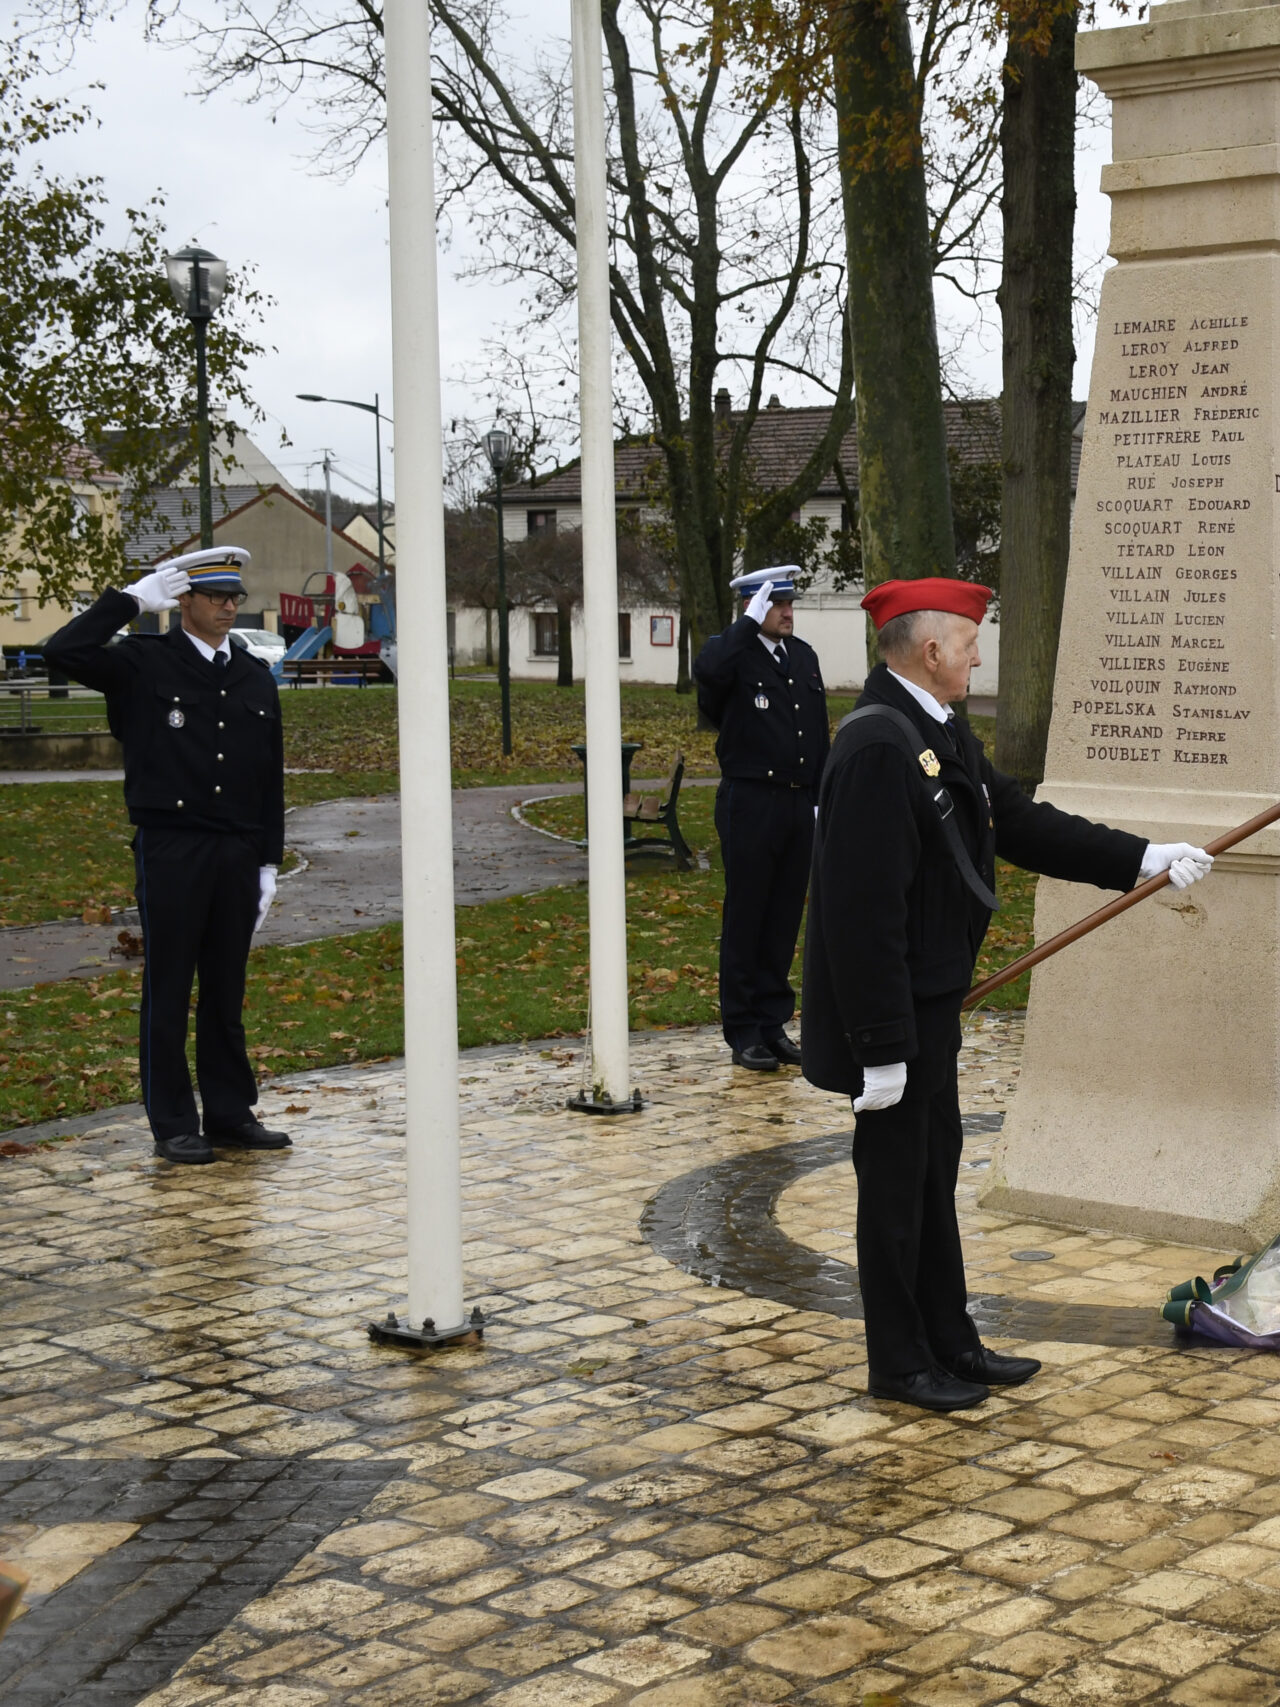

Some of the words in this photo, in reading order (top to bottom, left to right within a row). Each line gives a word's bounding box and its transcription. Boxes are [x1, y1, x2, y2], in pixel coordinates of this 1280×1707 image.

[1114, 319, 1175, 335] LEMAIRE
[1190, 317, 1248, 330] ACHILLE
[1122, 342, 1170, 357] LEROY
[1183, 340, 1238, 352] ALFRED
[1129, 364, 1179, 378] LEROY
[1192, 363, 1229, 375] JEAN
[1110, 386, 1187, 401] MAUCHIEN
[1098, 409, 1180, 424] MAZILLIER
[1212, 430, 1244, 442] PAUL
[1117, 454, 1180, 468] PLATEAU
[1192, 453, 1231, 466] LOUIS
[1171, 477, 1224, 488] JOSEPH
[1097, 499, 1173, 514] SCOQUART
[1188, 499, 1250, 510] EDOUARD
[1105, 522, 1182, 537] SCOQUART
[1101, 567, 1162, 579] VILLAIN
[1176, 568, 1237, 580] GEORGES
[1110, 590, 1169, 602] VILLAIN
[1184, 590, 1226, 602] JULES
[1106, 612, 1164, 625] VILLAIN
[1175, 613, 1224, 625] LUCIEN
[1105, 635, 1160, 647] VILLAIN
[1171, 636, 1224, 649] MARCEL
[1099, 658, 1165, 671] VILLIERS
[1091, 680, 1161, 695] VOILQUIN
[1174, 682, 1236, 695] RAYMOND
[1073, 701, 1156, 716] POPELSKA
[1172, 705, 1250, 719] STANISLAV
[1091, 724, 1163, 738] FERRAND
[1176, 728, 1226, 741] PIERRE
[1087, 747, 1161, 761] DOUBLET
[1174, 750, 1228, 764] KLEBER
